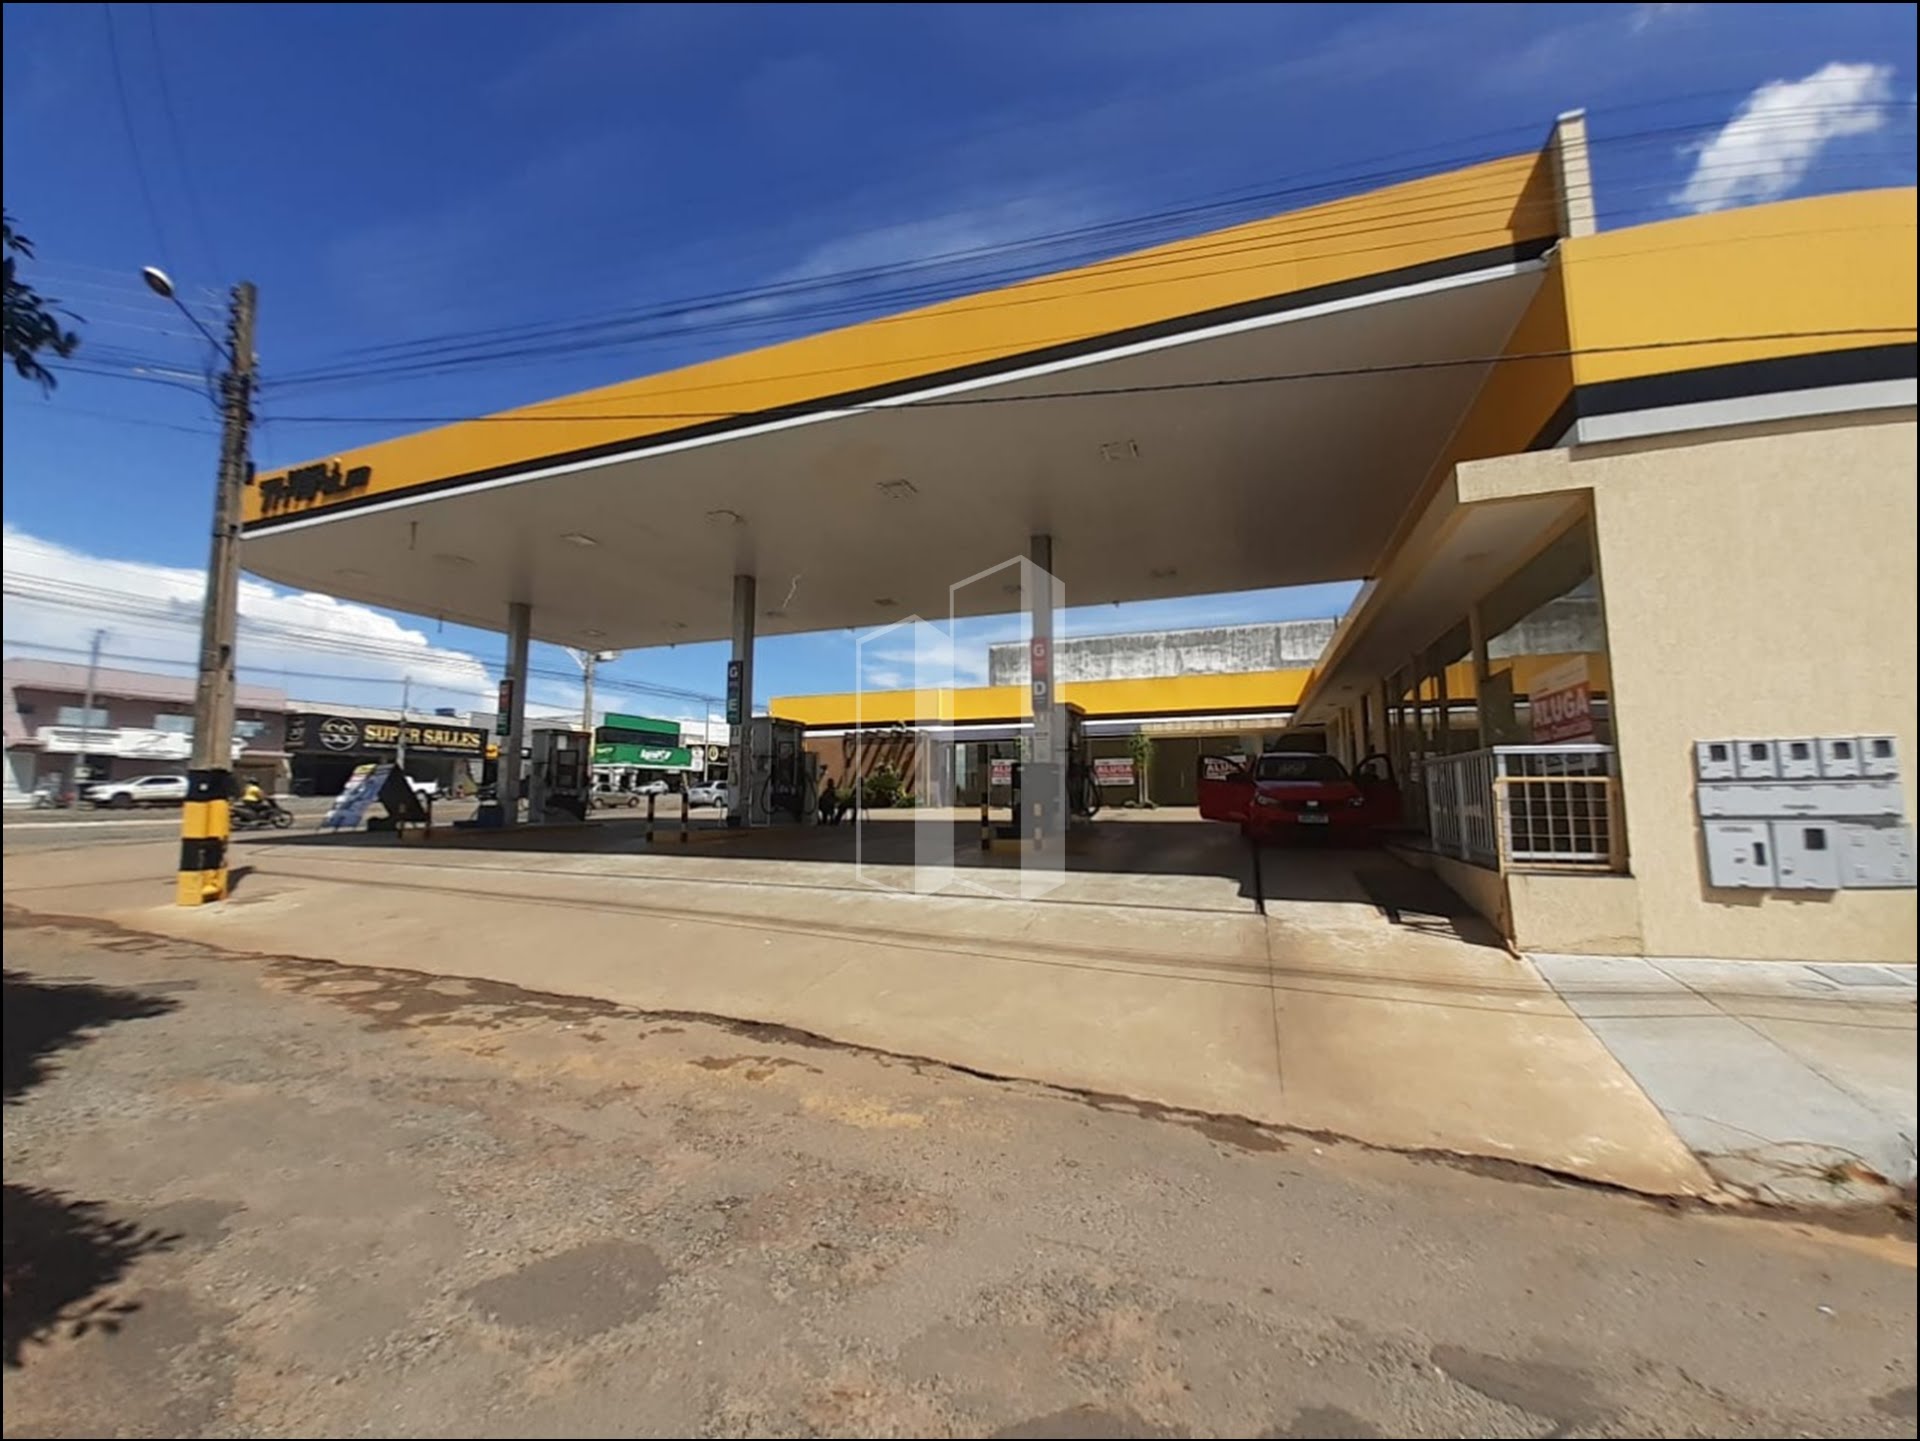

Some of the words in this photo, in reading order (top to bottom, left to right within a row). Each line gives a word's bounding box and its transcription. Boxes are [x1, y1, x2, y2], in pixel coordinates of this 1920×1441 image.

[1033, 644, 1045, 657] G
[1034, 681, 1046, 696] D
[1533, 688, 1589, 729] ALUGA
[423, 729, 480, 748] SALLES
[1097, 765, 1132, 773] ALUGA
